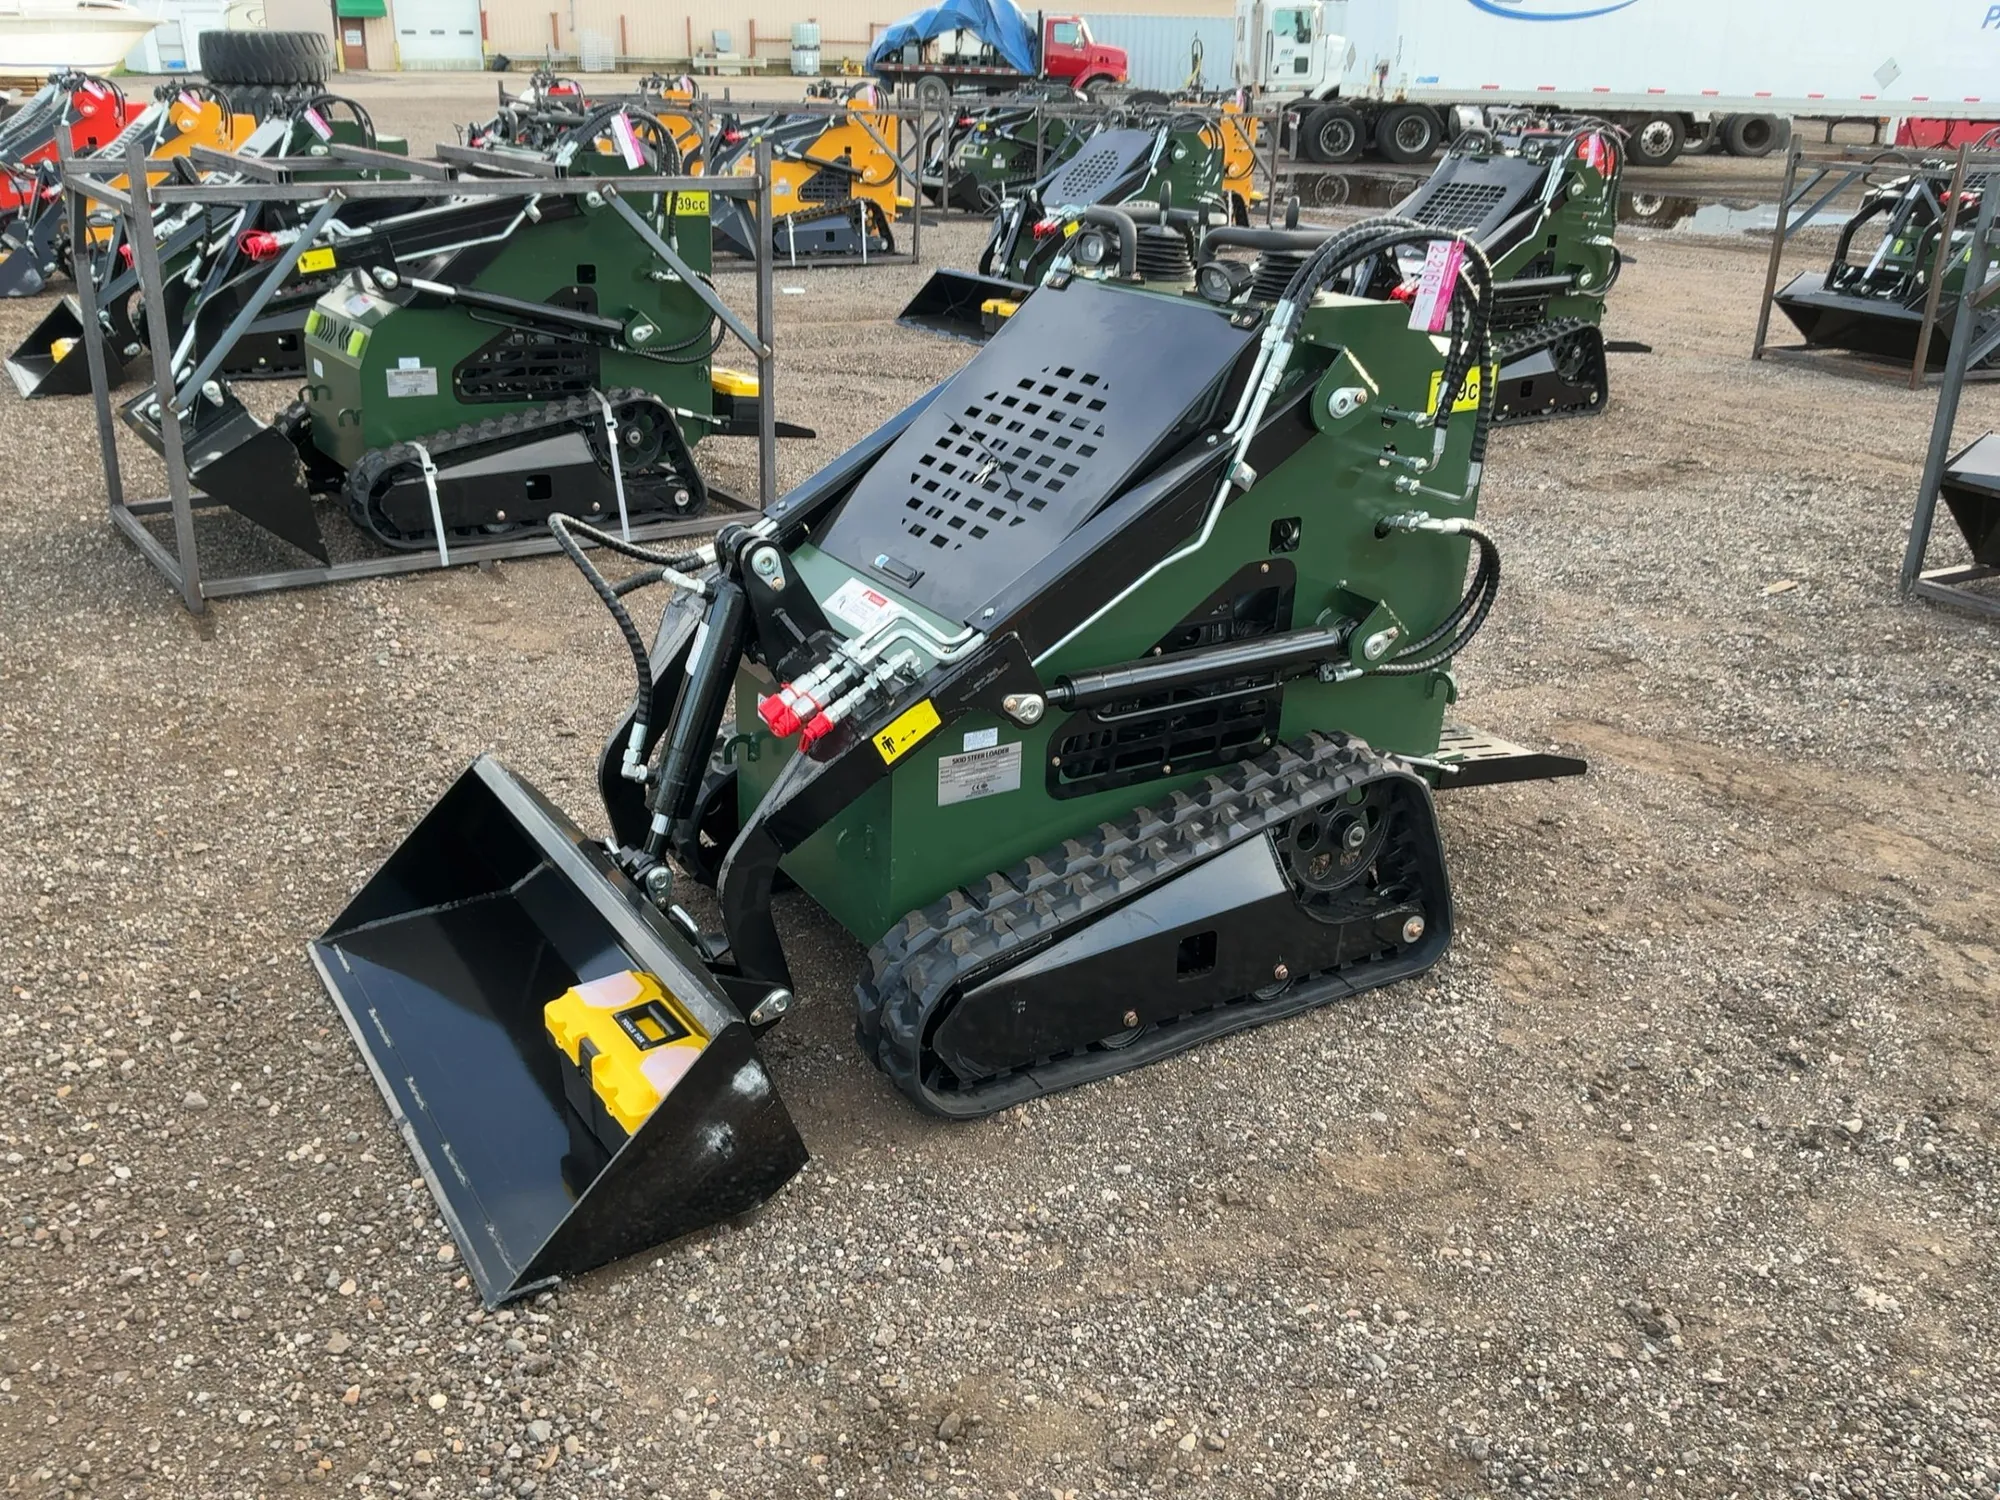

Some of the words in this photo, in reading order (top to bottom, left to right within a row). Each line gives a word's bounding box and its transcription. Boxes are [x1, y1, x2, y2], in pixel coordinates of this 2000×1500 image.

[677, 197, 706, 211] 39cc
[952, 756, 967, 765] SKID
[967, 753, 985, 762] STEER
[985, 747, 1010, 759] LOADER
